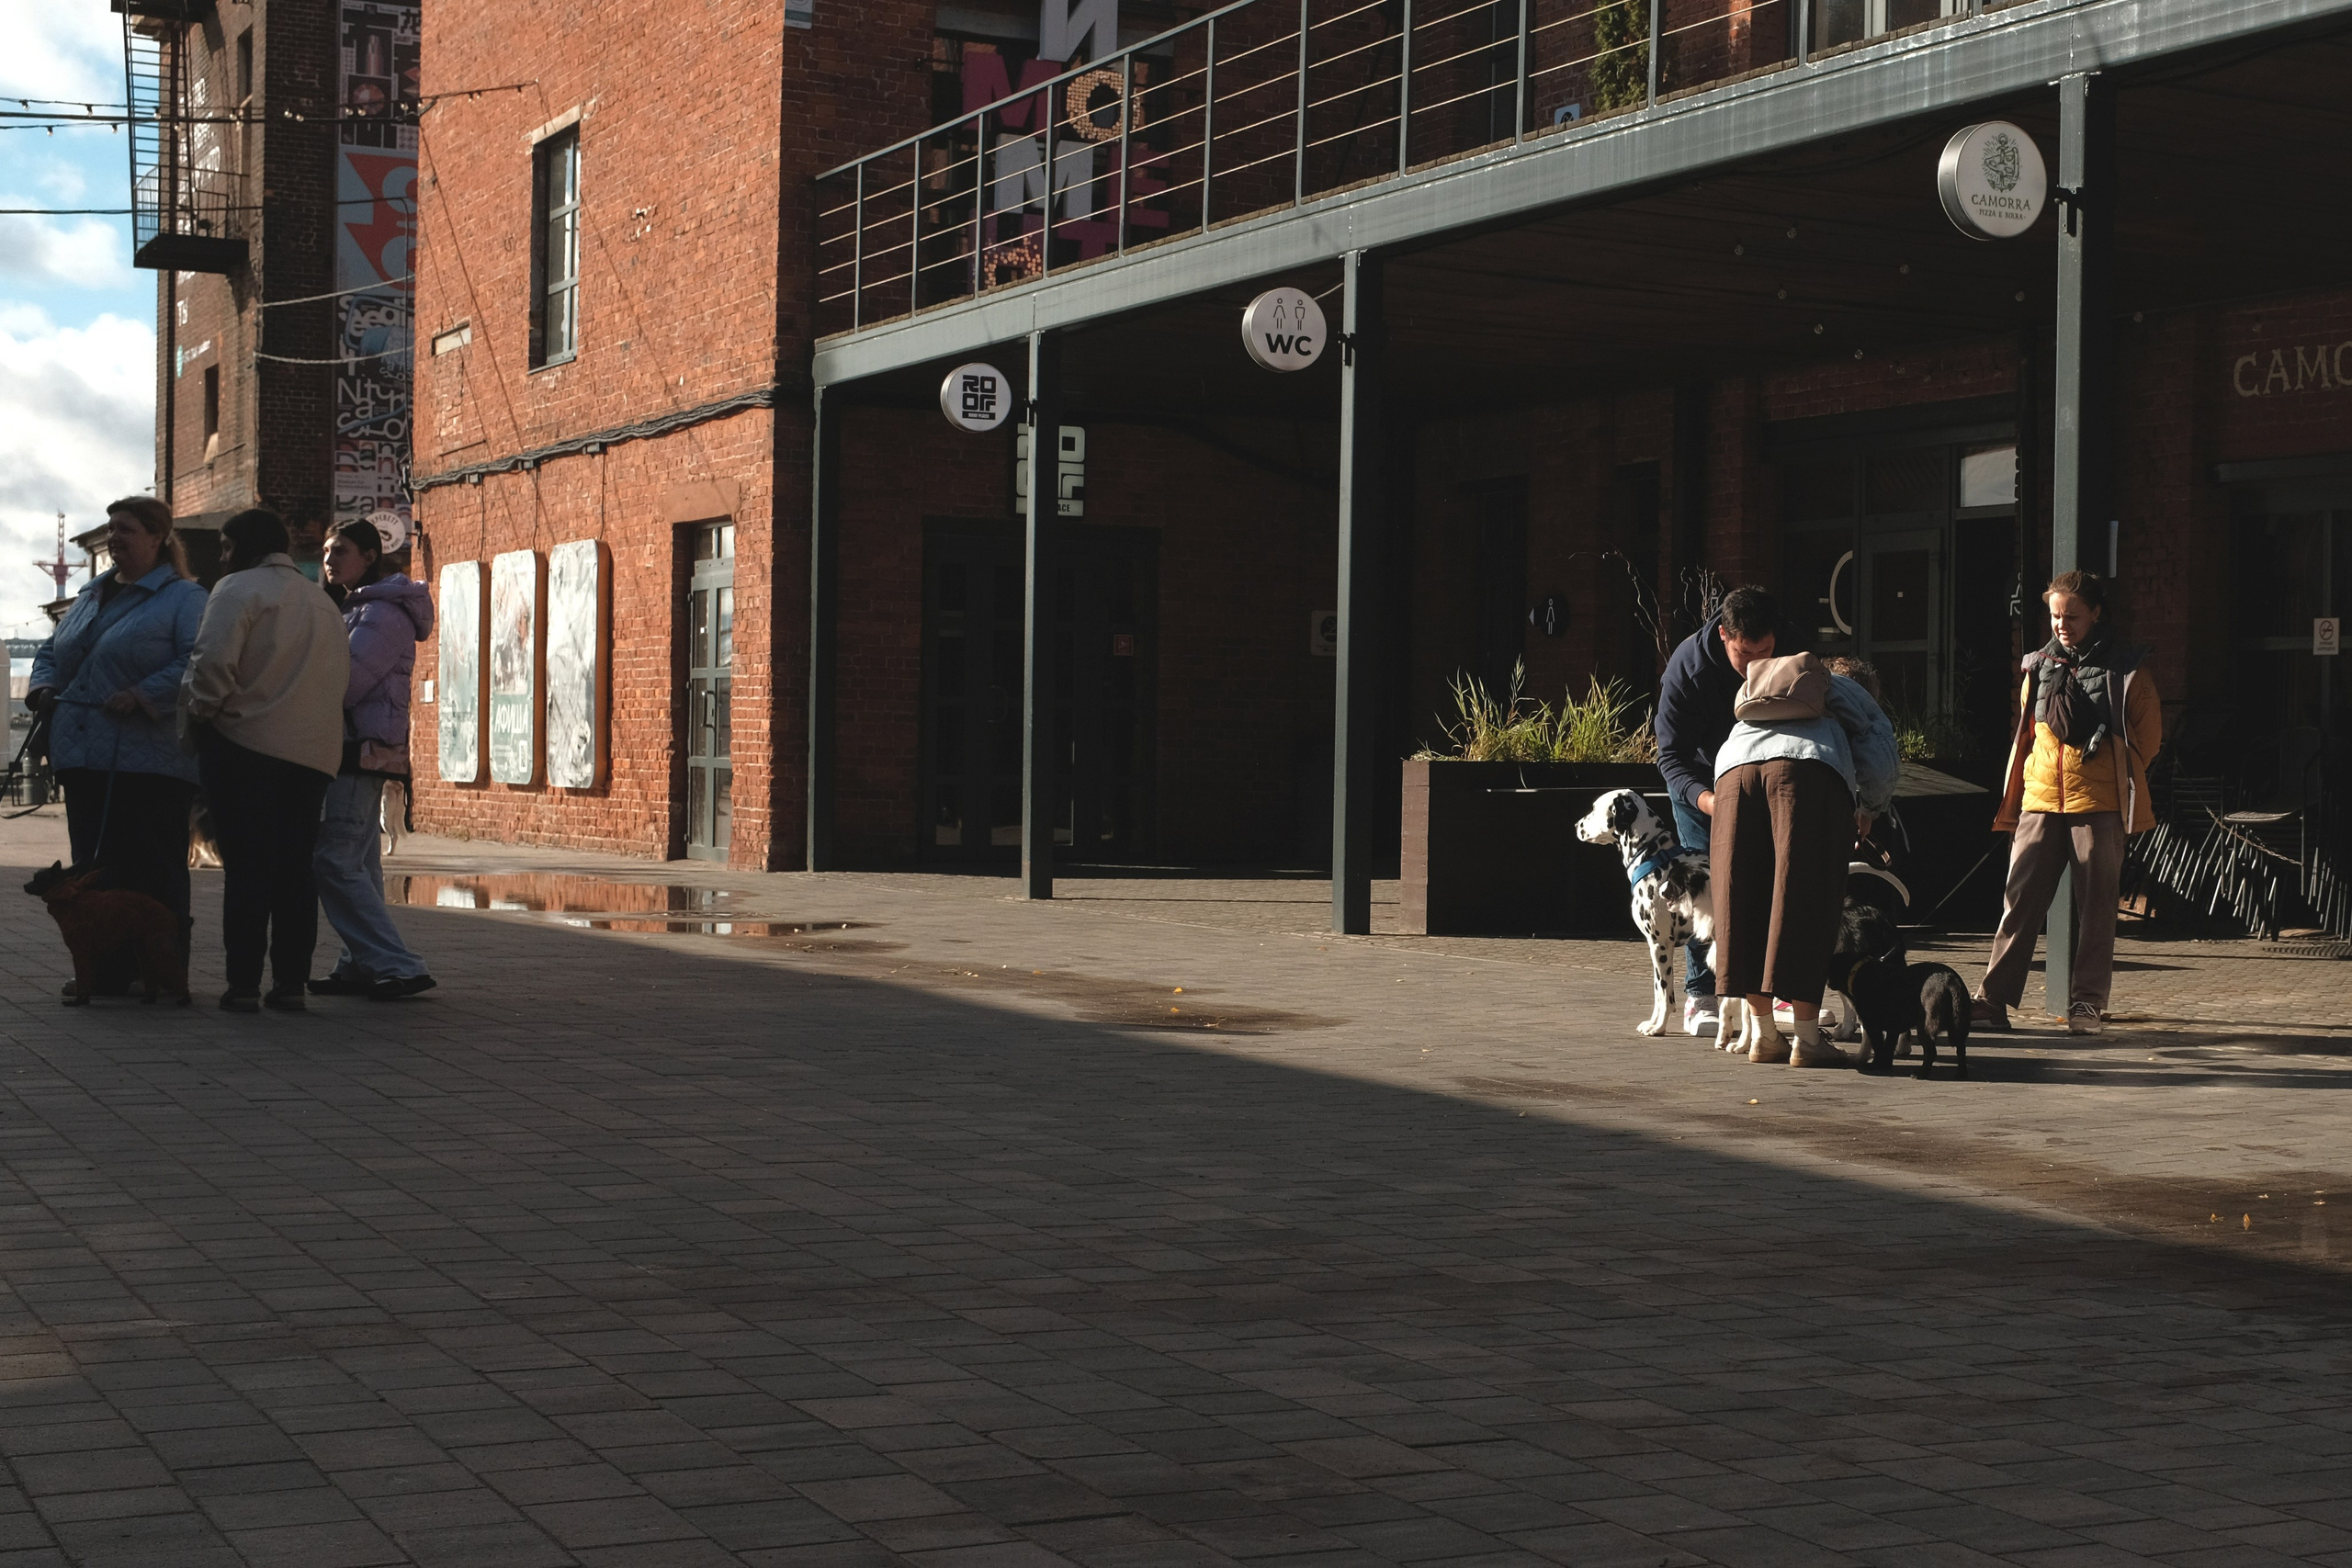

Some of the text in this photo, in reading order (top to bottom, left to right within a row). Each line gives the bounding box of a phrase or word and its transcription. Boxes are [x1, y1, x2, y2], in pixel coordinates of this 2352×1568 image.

[1971, 194, 2031, 211] CAMORRA
[1978, 209, 1996, 218] PIZZA
[1265, 333, 1312, 356] WC
[494, 704, 528, 733] АФИША
